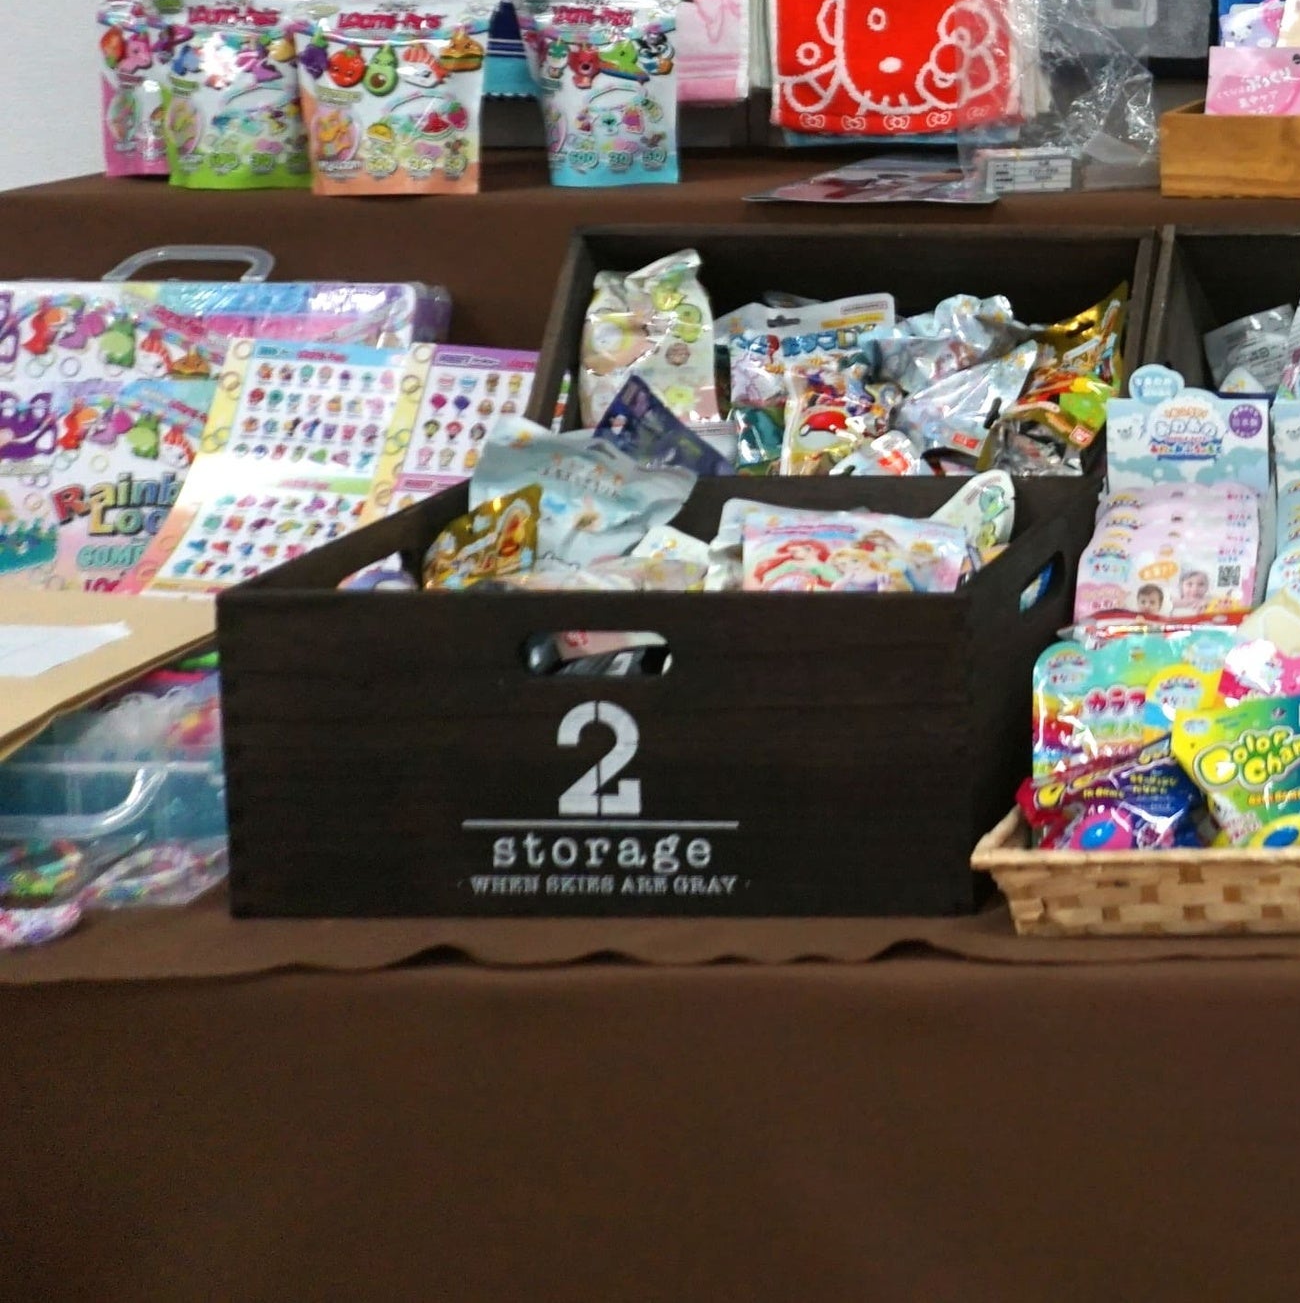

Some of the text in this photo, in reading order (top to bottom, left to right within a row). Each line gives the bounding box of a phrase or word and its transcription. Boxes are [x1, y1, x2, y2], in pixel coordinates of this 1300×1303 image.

[557, 700, 641, 816] 2
[493, 833, 712, 875] storage
[471, 875, 738, 895] WHEN SKIES ARE GRAY
